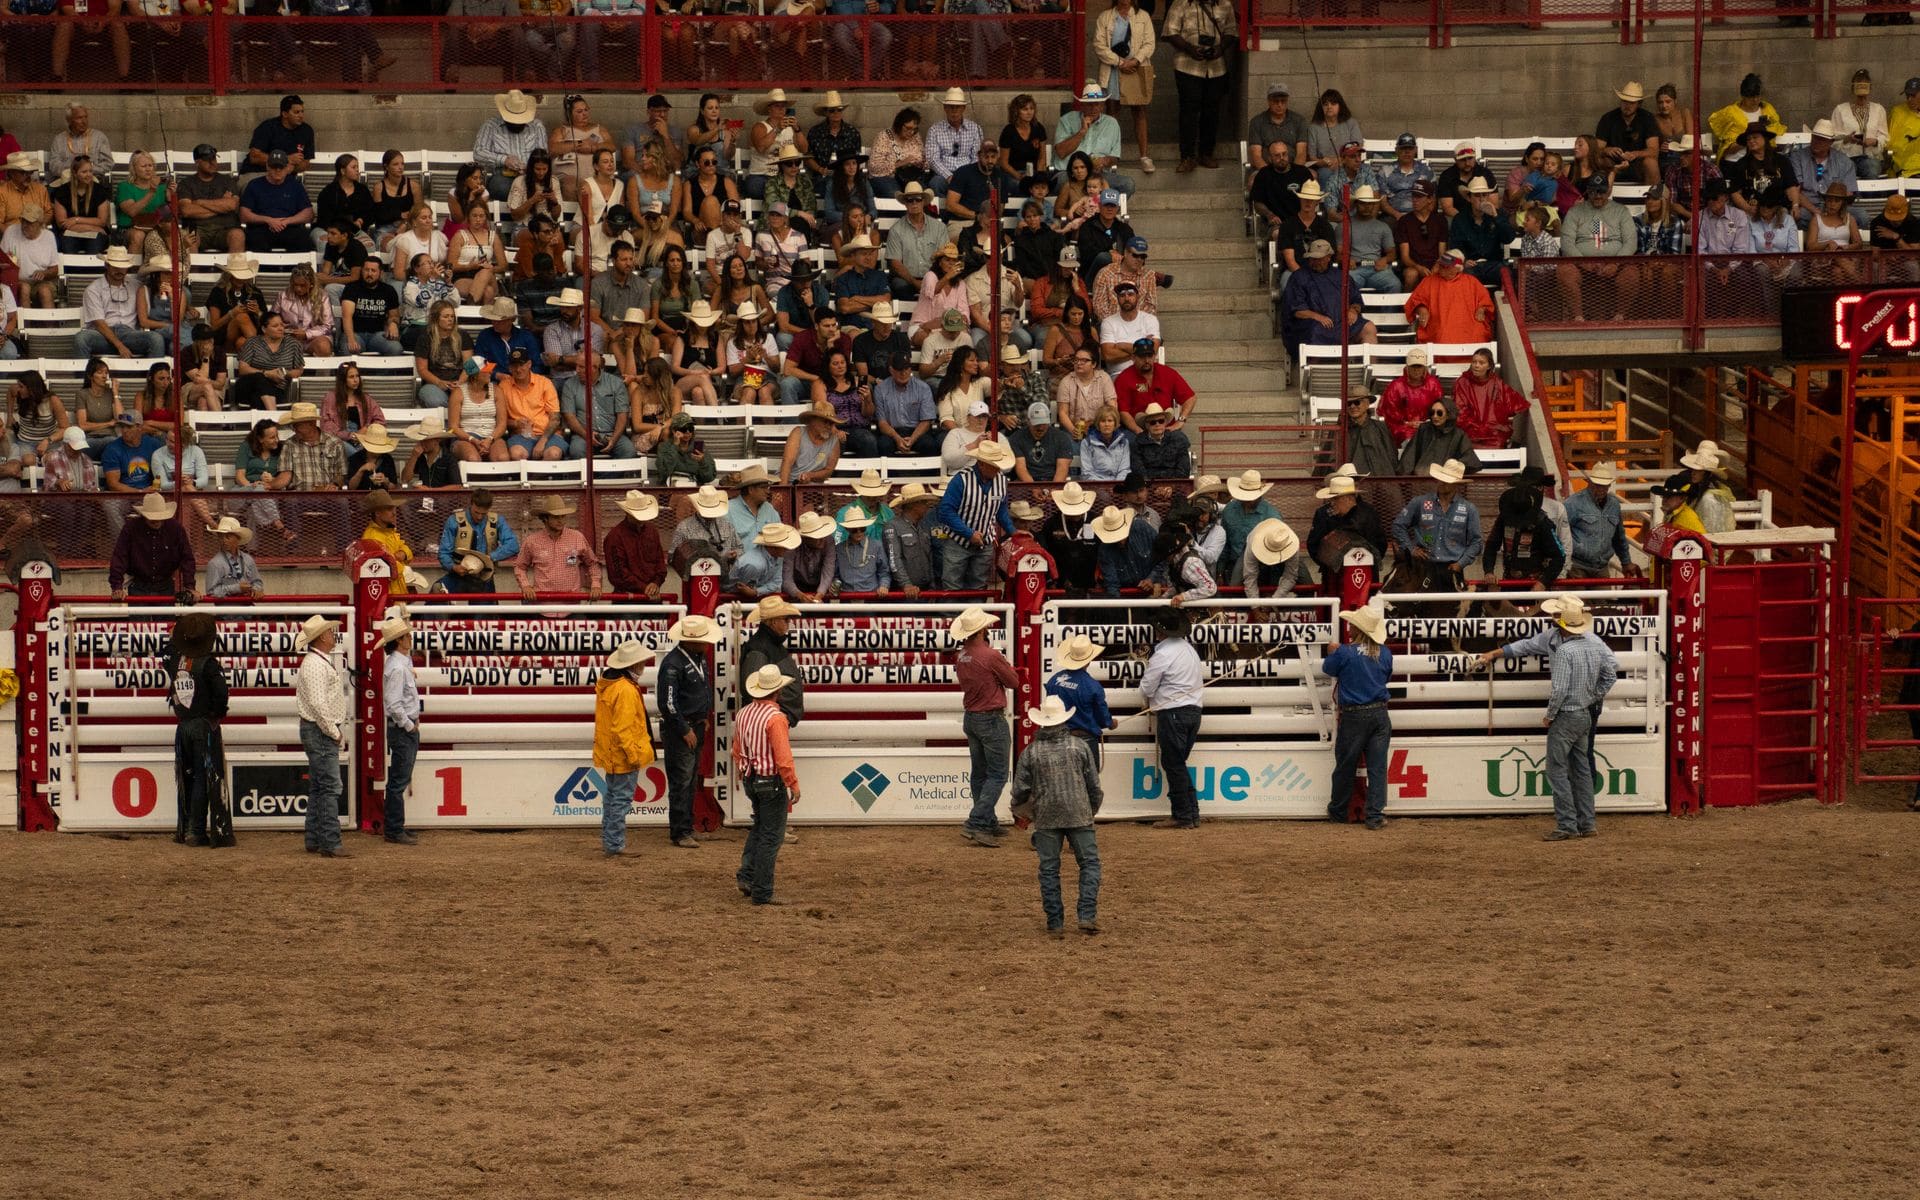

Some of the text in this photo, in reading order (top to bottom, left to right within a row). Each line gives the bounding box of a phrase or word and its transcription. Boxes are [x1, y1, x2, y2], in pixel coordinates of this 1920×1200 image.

[1062, 626, 1157, 644] CHEYENN
[1187, 624, 1263, 643] ONTIER
[1386, 619, 1486, 638] CHEYENNE
[1494, 618, 1551, 638] FRONT
[413, 631, 504, 651] HEYENNE
[510, 631, 604, 650] FRONTIER
[844, 629, 938, 648] FRONTIER
[851, 665, 874, 683] OF
[1100, 660, 1145, 680] "DAD
[1504, 655, 1528, 673] OF
[106, 669, 166, 689] "DADD
[176, 681, 194, 690] 1148
[518, 667, 542, 686] OF
[1691, 593, 1700, 781] CHEYENNE
[48, 616, 61, 807] CHEYENNE
[716, 612, 728, 800] CHEYENNE
[898, 771, 958, 786] Cheyenne
[1132, 757, 1251, 801] bue
[1387, 750, 1429, 798] 4
[1482, 759, 1638, 797] Unn
[112, 767, 157, 818] 0
[435, 766, 467, 816] 1
[909, 787, 956, 799] Medical
[239, 789, 310, 814] devo
[552, 804, 604, 816] Albertso
